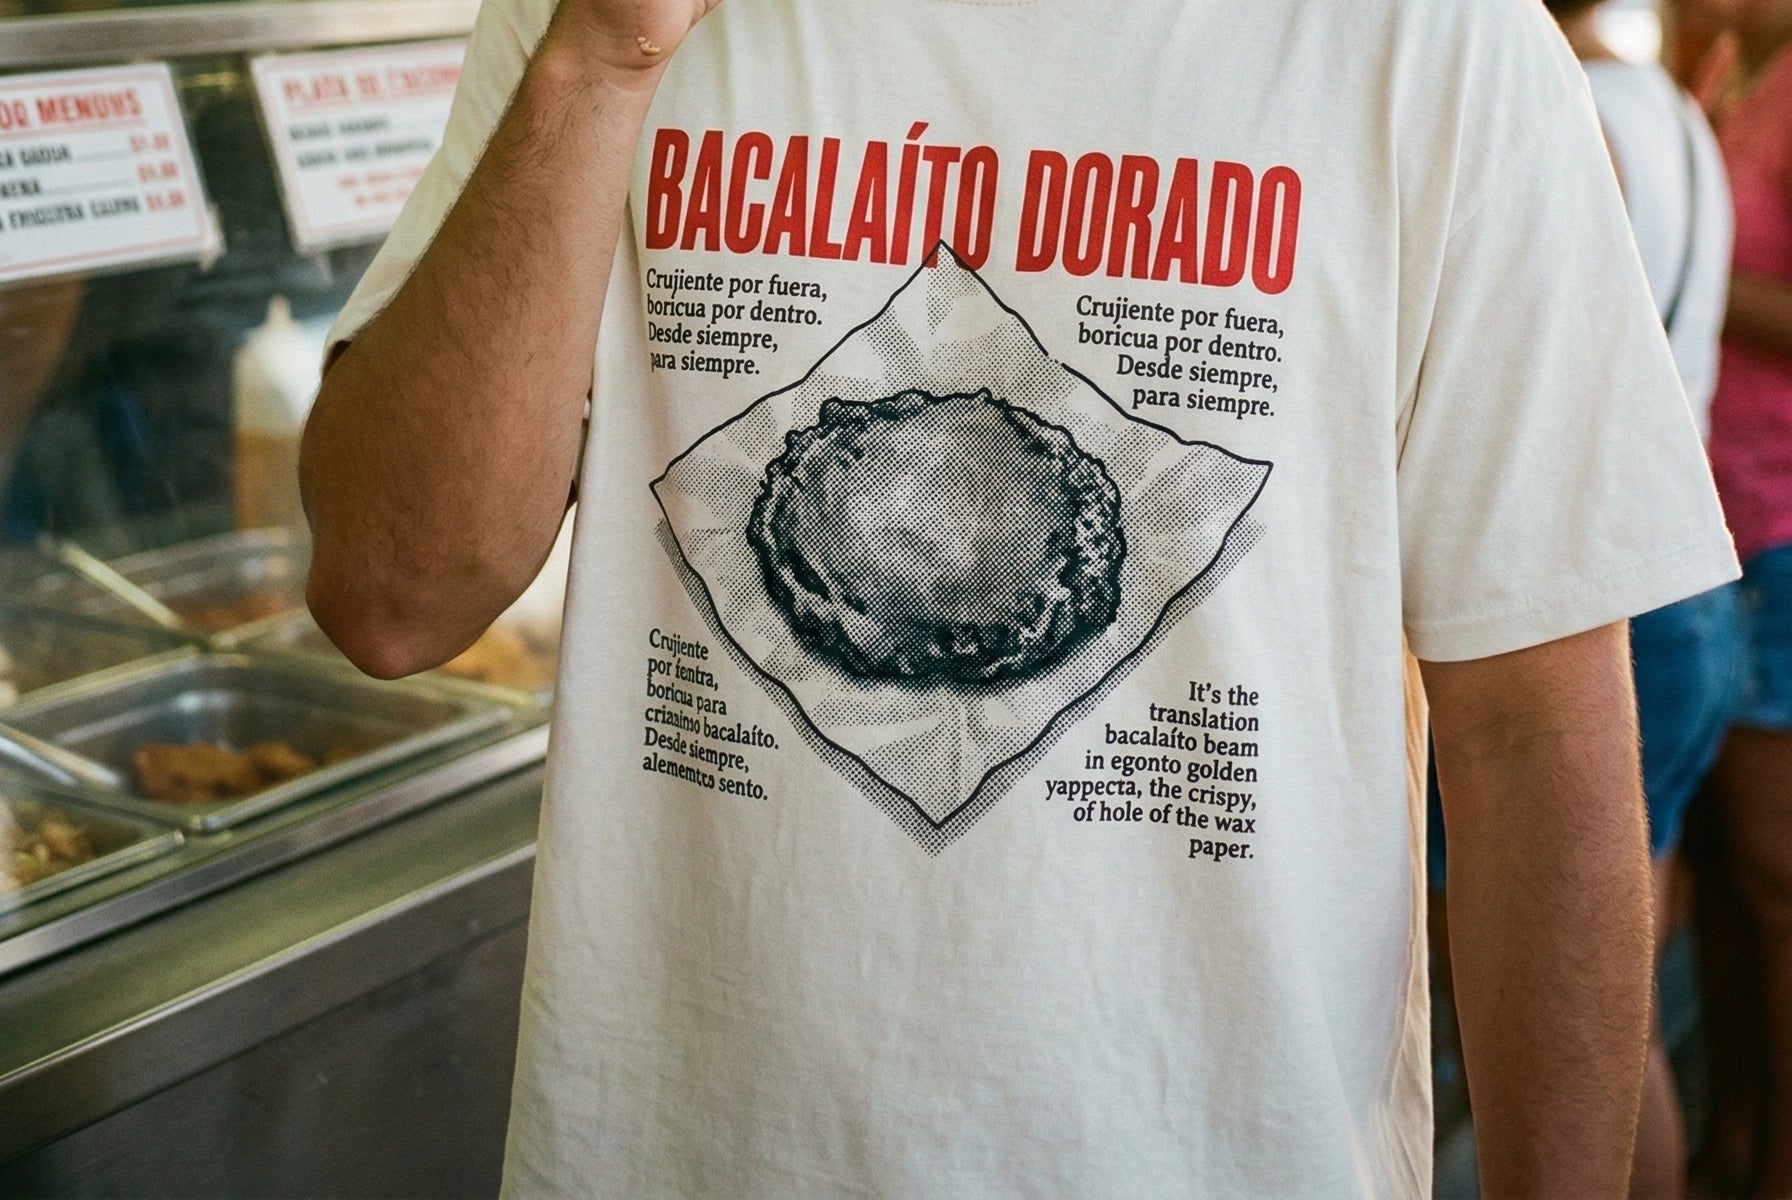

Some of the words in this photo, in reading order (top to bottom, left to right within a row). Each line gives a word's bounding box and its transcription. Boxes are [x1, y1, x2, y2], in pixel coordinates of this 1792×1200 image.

[645, 121, 999, 272] BACALAÍTO
[1015, 150, 1301, 295] DORADO
[647, 268, 723, 299] Crujiente
[728, 276, 763, 298] por
[768, 274, 827, 302] fuera,
[647, 294, 705, 317] boricua
[711, 303, 744, 324] por
[750, 300, 822, 325] dentro.
[1076, 295, 1174, 324] Crujiente
[1180, 309, 1218, 330] por
[1225, 308, 1284, 338] fuera,
[648, 321, 692, 343] Desde
[696, 324, 778, 353] siempre,
[1078, 322, 1158, 349] boricua
[1164, 335, 1202, 356] por
[1208, 334, 1282, 362] dentro.
[650, 352, 676, 372] para
[681, 350, 760, 379] siempre.
[1117, 354, 1182, 379] Desde
[1189, 361, 1278, 393] siempre,
[1132, 388, 1180, 409] para
[1187, 389, 1275, 419] siempre.
[649, 628, 709, 660] Crujiente
[647, 658, 672, 677] por
[647, 678, 693, 707] boricua
[697, 696, 727, 715] para
[1189, 681, 1221, 703] It's
[1228, 685, 1259, 706] the
[703, 716, 778, 749] bacalaíto.
[1150, 703, 1259, 731] translation
[644, 727, 686, 754] Desde
[689, 740, 749, 773] siempre,
[1105, 723, 1197, 751] bacalaíto
[1204, 734, 1259, 757] beam
[1085, 750, 1104, 769] in
[1111, 755, 1181, 776] egonto
[1187, 760, 1258, 782] golden
[719, 777, 768, 800] sento.
[1150, 777, 1182, 799] the
[1188, 785, 1257, 813] crispy,
[1073, 801, 1096, 821] of
[1100, 801, 1143, 821] hole
[1150, 804, 1173, 823] of
[1176, 806, 1209, 829] the
[1215, 816, 1256, 833] wax
[1189, 838, 1253, 861] paper.
